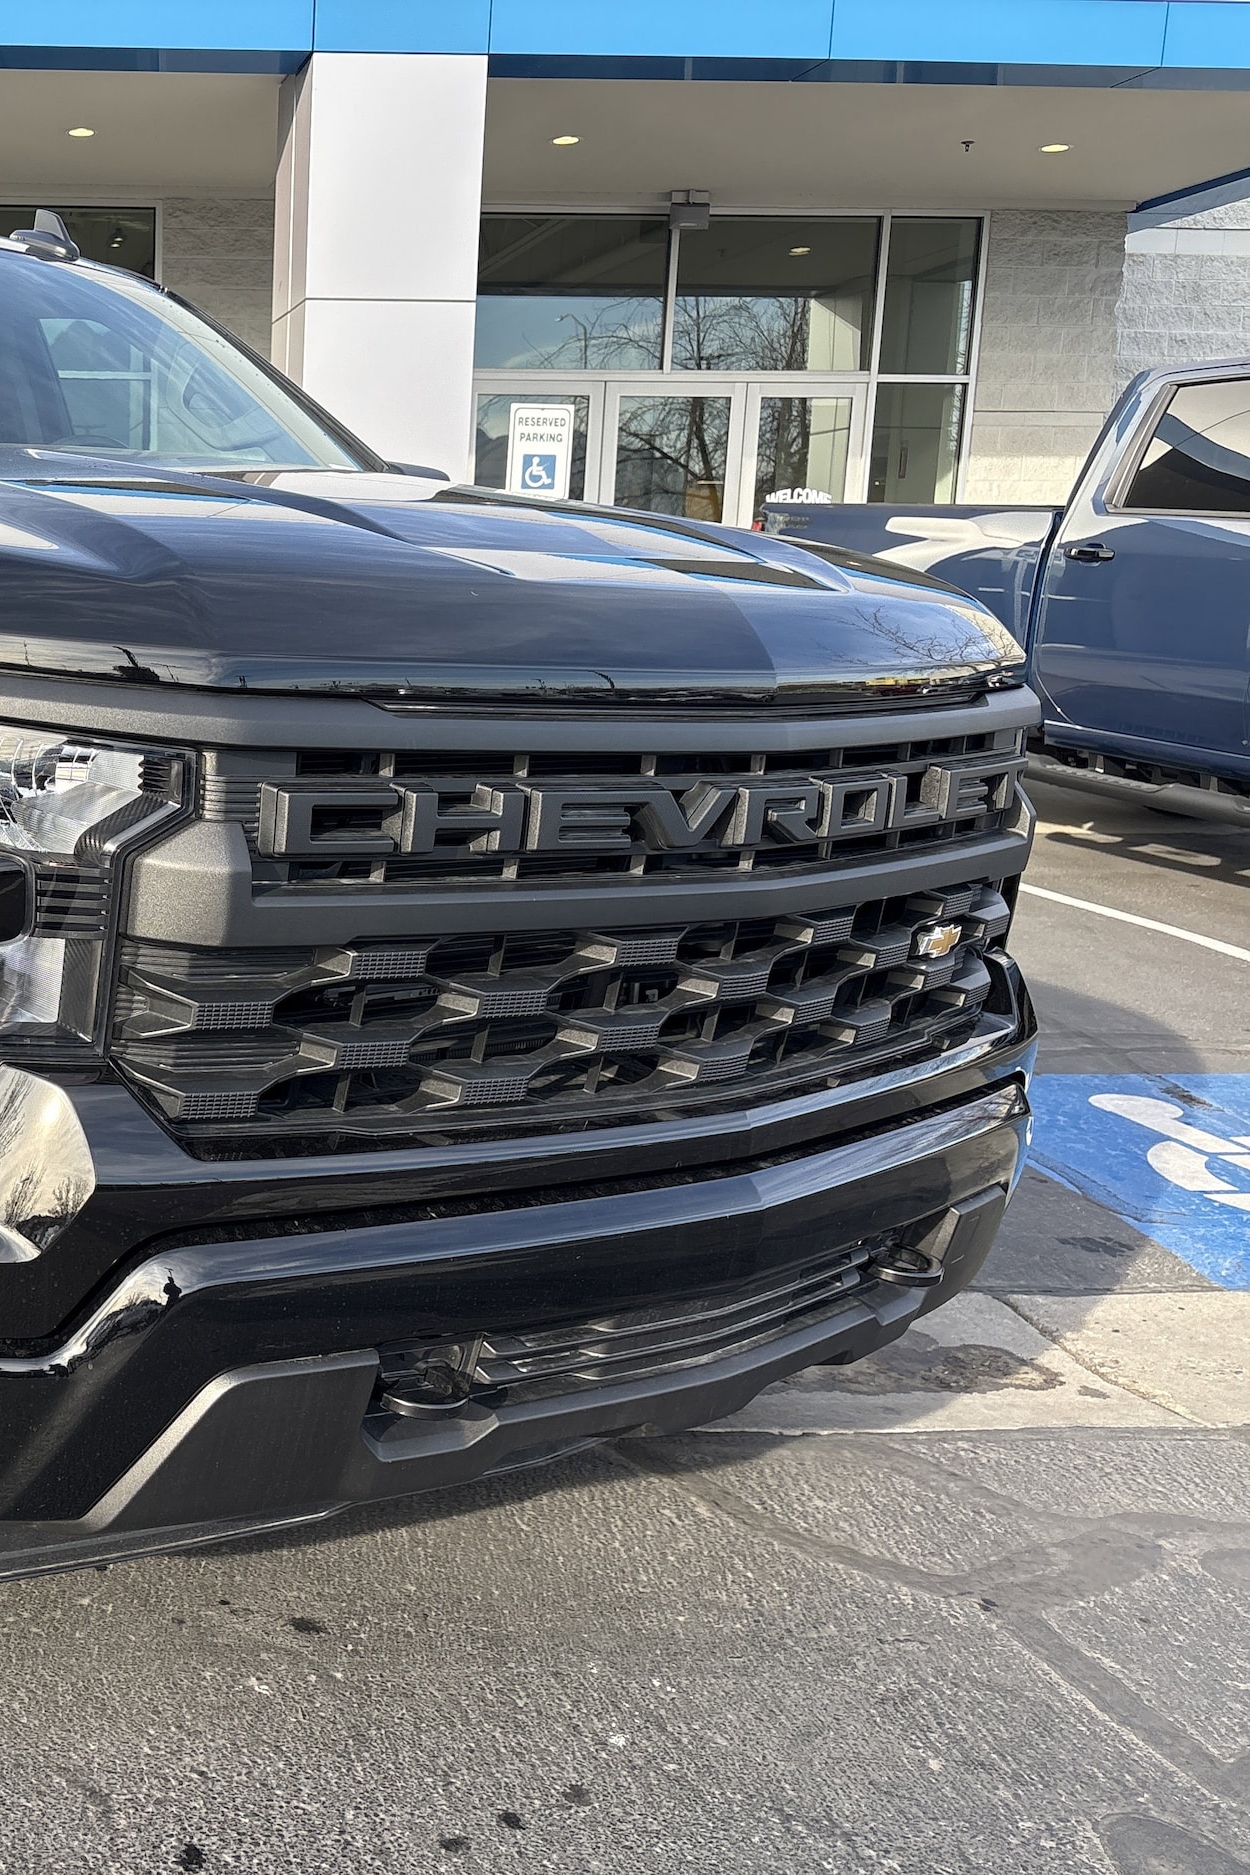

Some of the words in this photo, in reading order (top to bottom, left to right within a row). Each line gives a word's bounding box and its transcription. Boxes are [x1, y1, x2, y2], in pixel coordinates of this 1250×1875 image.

[518, 416, 566, 427] RESERVED
[519, 432, 563, 443] PARKING
[765, 487, 832, 504] WELCOME
[257, 758, 1029, 857] CHEVROLET
